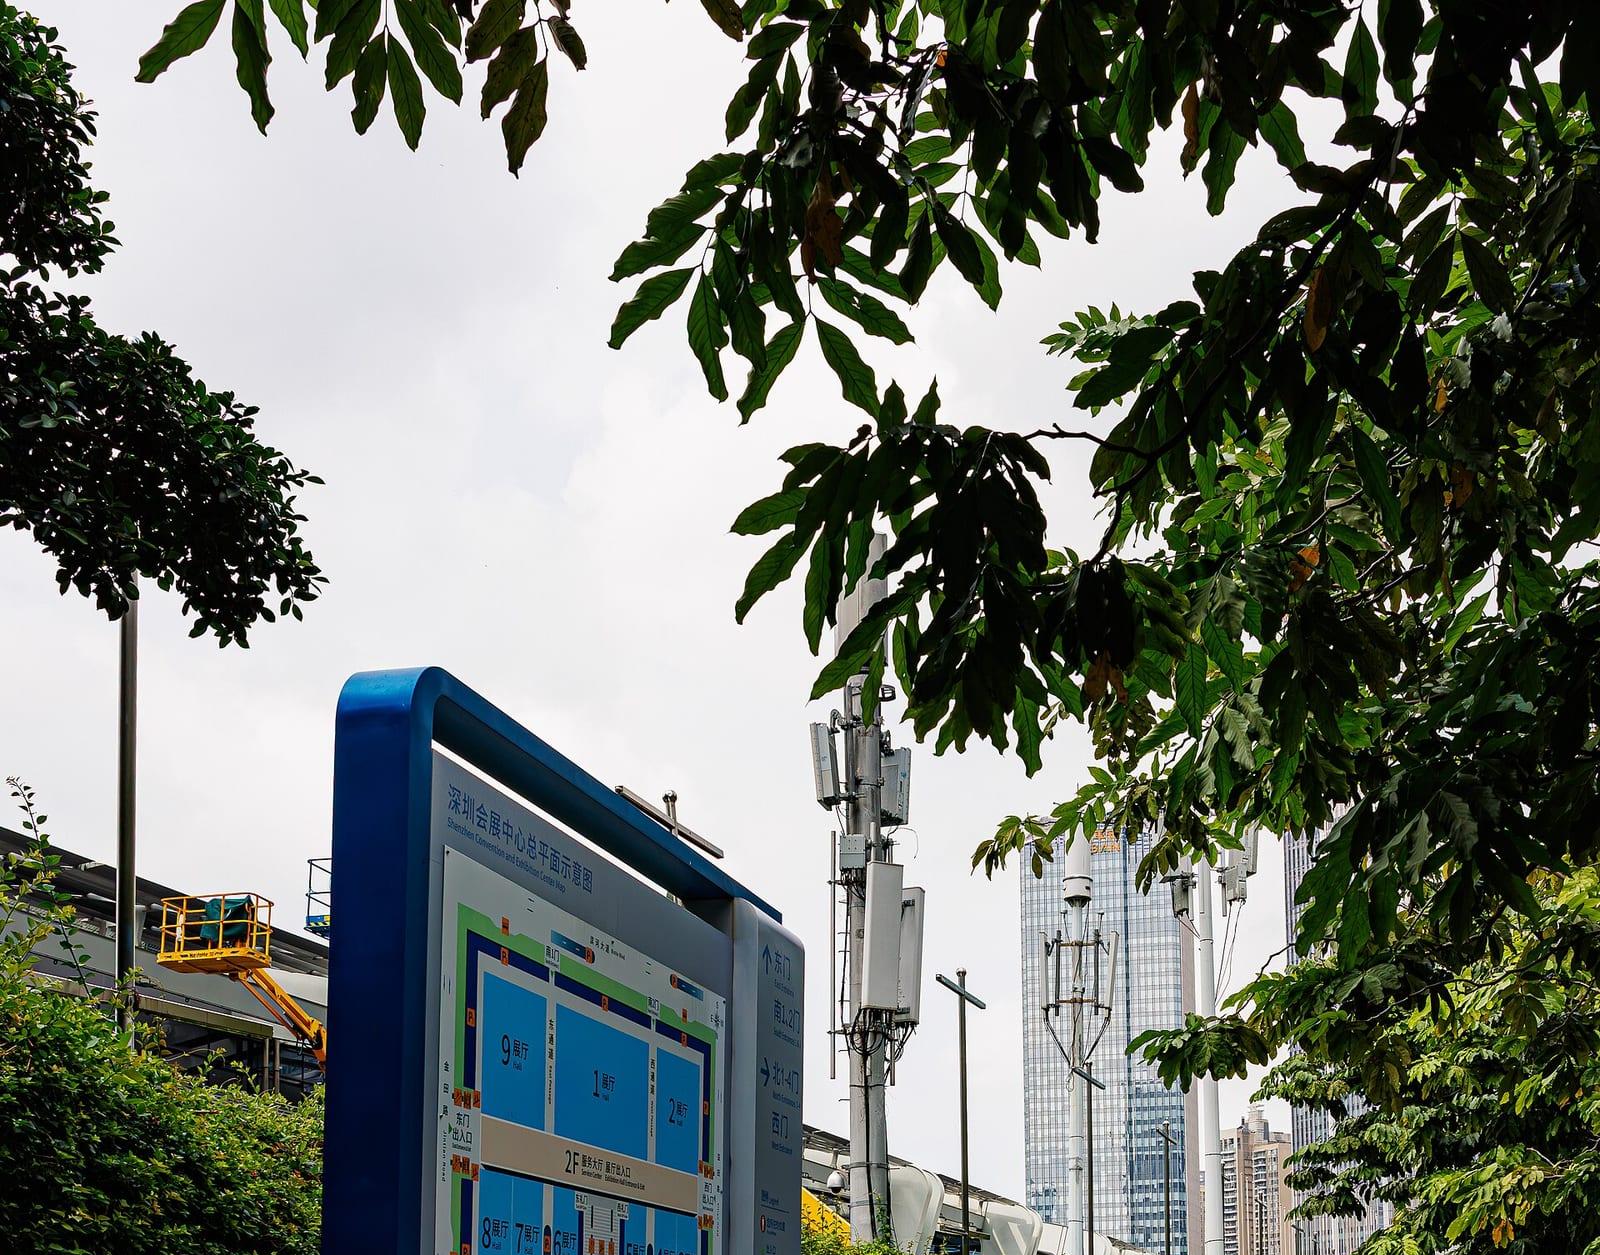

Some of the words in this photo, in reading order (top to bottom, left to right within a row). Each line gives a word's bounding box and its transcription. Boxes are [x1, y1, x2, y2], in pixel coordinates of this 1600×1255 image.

[447, 817, 475, 841] Shenzhen
[475, 833, 505, 858] Convention
[505, 853, 516, 864] and
[515, 856, 540, 878] Exhibition
[448, 783, 593, 893] 深圳会展中心总平面示意图
[774, 950, 791, 981] 东门
[501, 1034, 511, 1065] 9
[513, 1039, 528, 1060] 展厅
[593, 1070, 600, 1097] 1
[456, 1111, 470, 1129] 东门
[669, 1098, 675, 1124] 2
[772, 1111, 788, 1139] 西门
[452, 1127, 472, 1145] 出入口
[565, 1149, 580, 1175] 2F
[482, 1217, 491, 1248] 8
[491, 1219, 509, 1239] 展厅
[515, 1223, 524, 1254] 7
[524, 1224, 540, 1244] 展厅
[562, 1231, 576, 1250] 展厅
